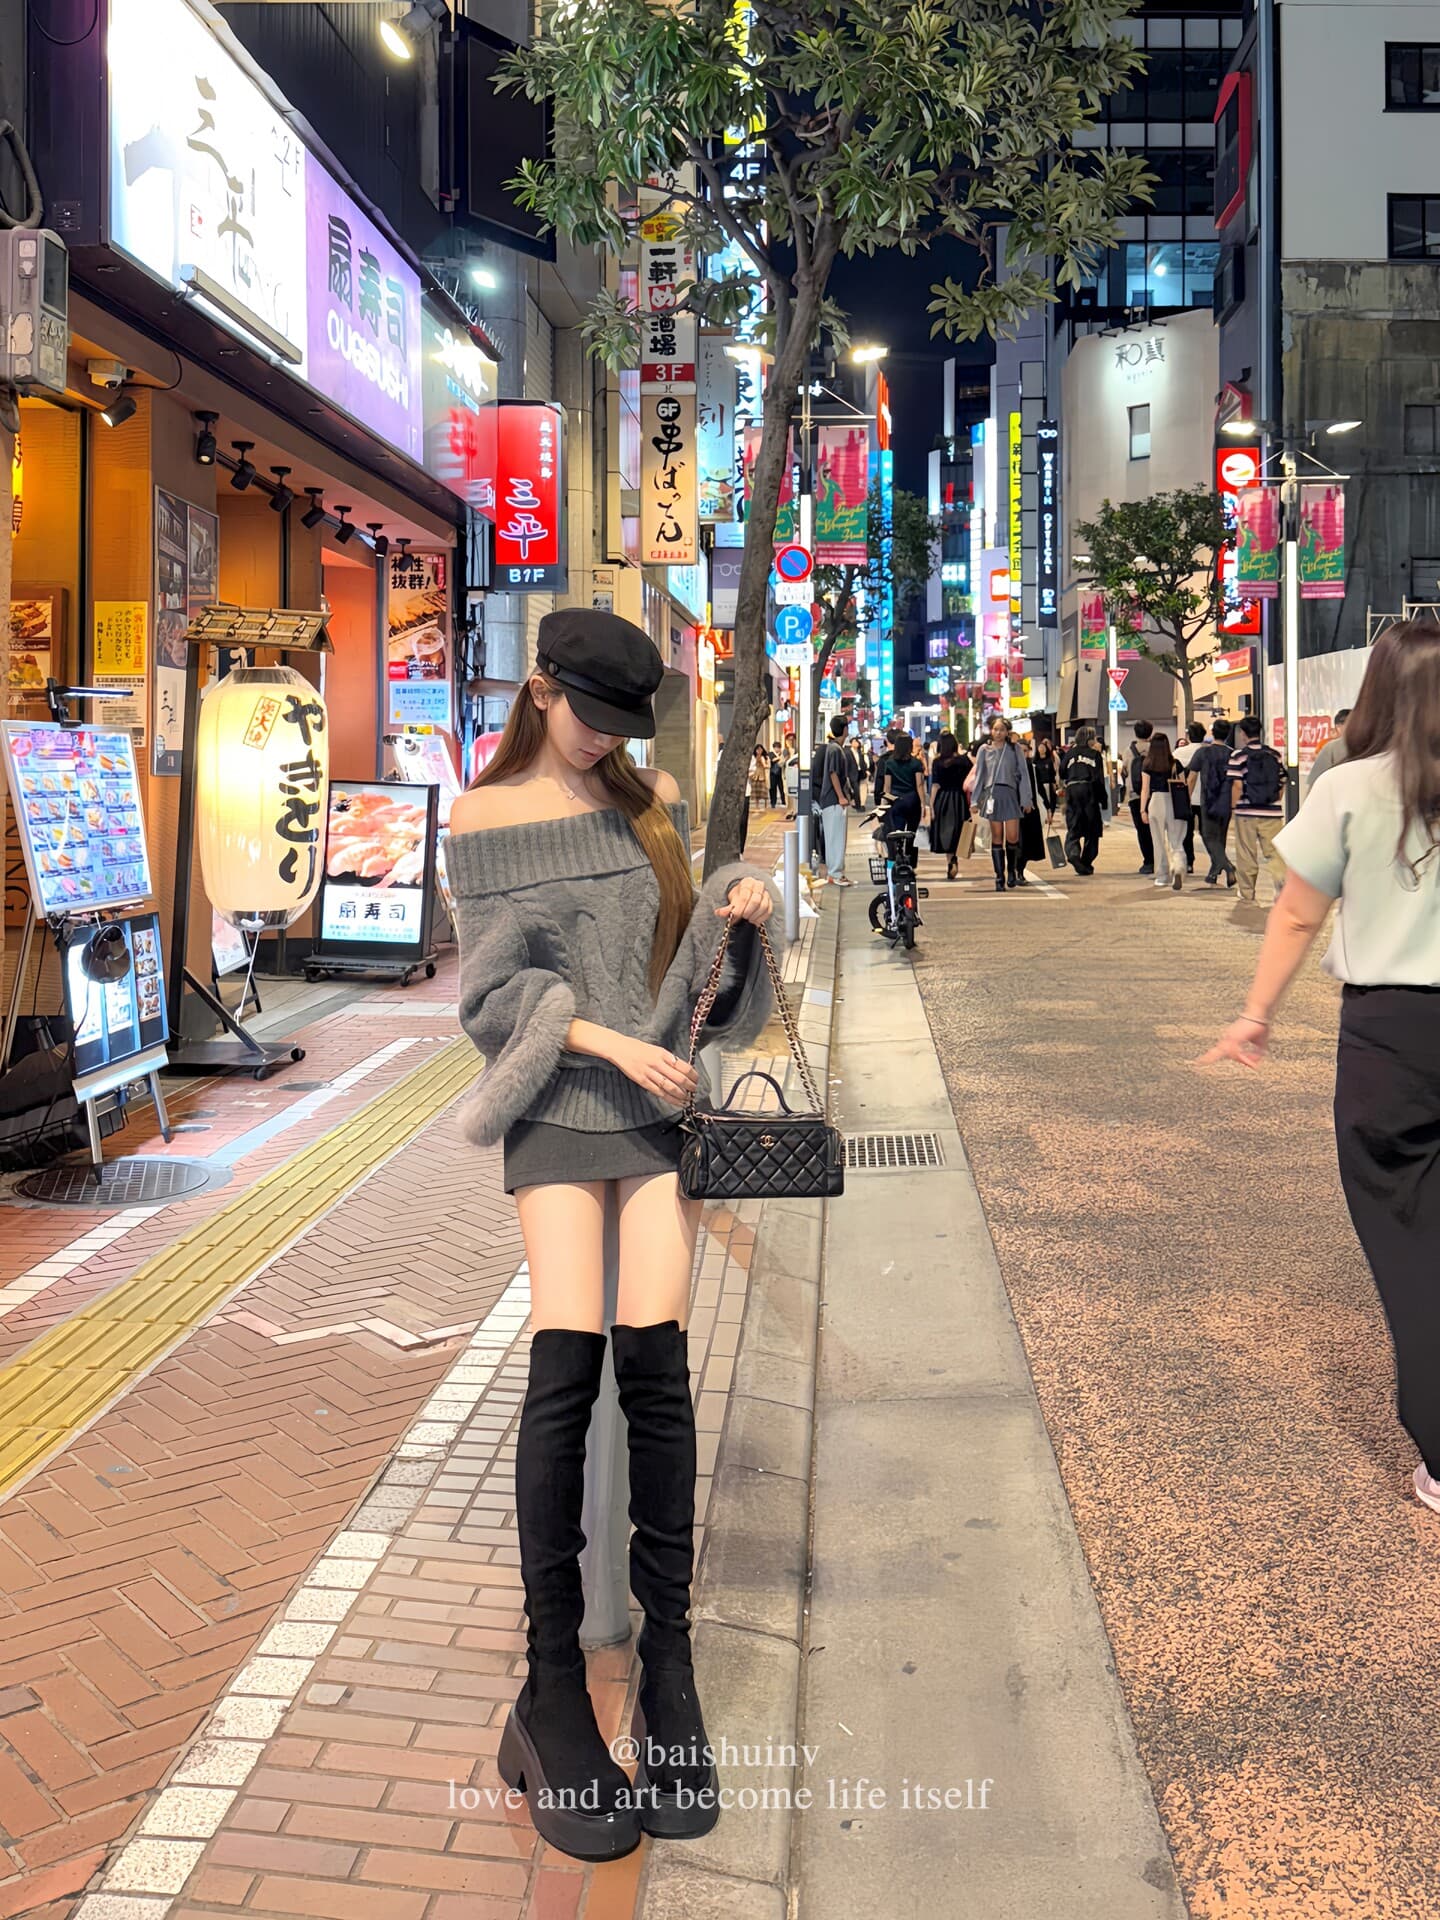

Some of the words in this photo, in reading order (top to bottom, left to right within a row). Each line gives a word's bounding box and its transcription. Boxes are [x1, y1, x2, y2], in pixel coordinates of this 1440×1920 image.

[730, 163, 760, 181] 4F
[328, 213, 408, 364] 扇寿司
[327, 308, 409, 411] OUGISUSHI
[655, 365, 684, 381] 3F
[657, 402, 679, 418] 6F
[652, 422, 686, 543] 串ばってん
[1041, 453, 1054, 505] WASHIN
[499, 477, 549, 560] 三平
[1042, 513, 1053, 575] OPTICAL
[391, 573, 431, 590] 抜群!
[508, 568, 545, 583] B1F
[784, 615, 800, 639] P
[276, 695, 326, 900] やきとり
[339, 901, 406, 921] 扇寿司
